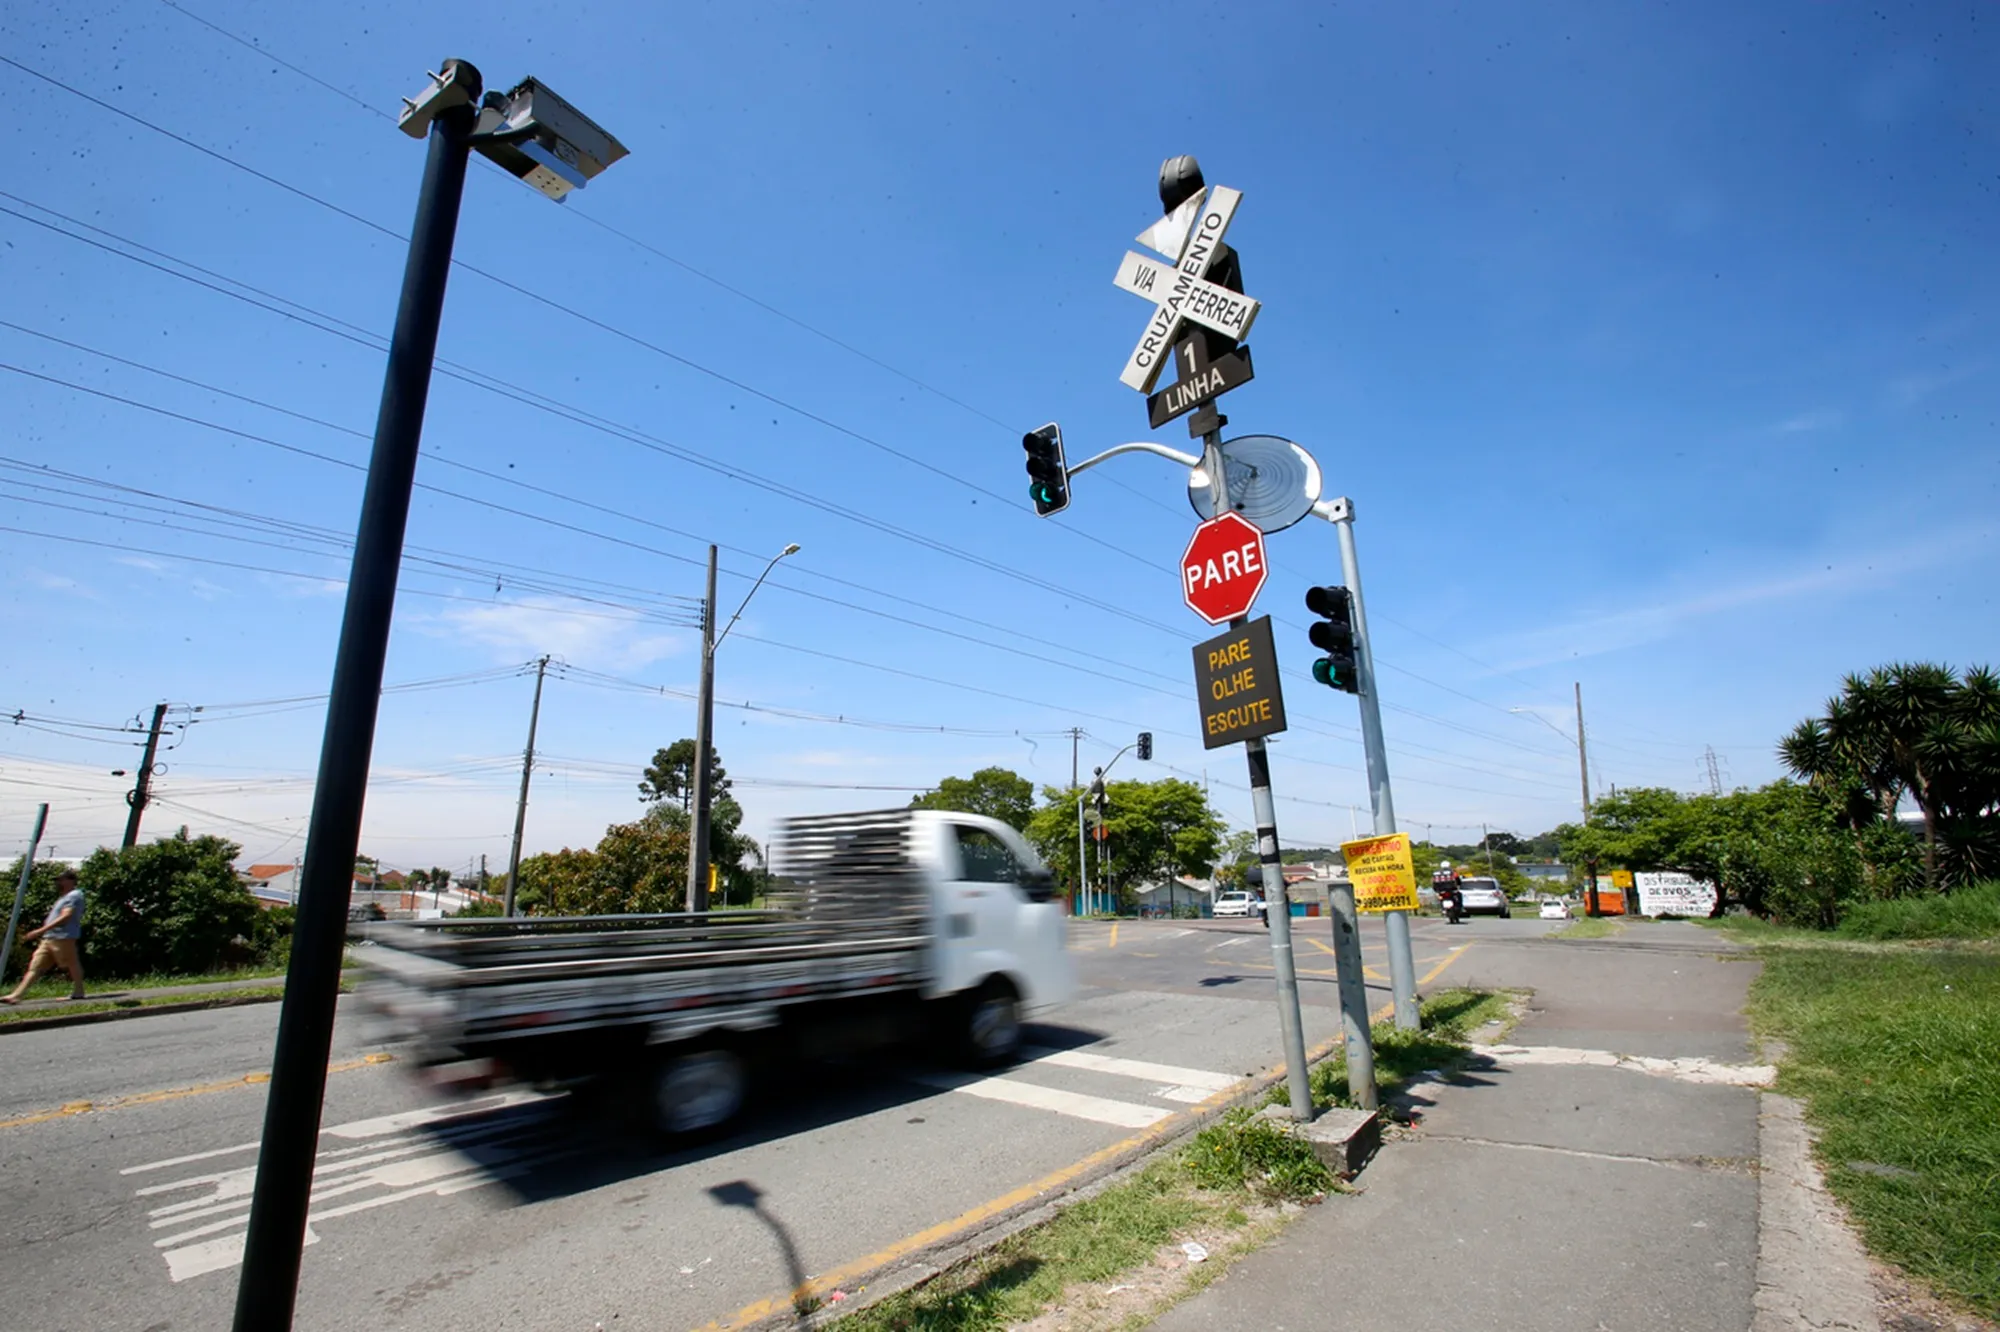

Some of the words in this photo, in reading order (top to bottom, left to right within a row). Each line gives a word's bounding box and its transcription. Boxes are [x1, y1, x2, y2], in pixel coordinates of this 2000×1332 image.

[1133, 263, 1157, 292] VIA
[1183, 284, 1248, 330] FÉRREA
[1135, 212, 1222, 368] CRUZAMENTO
[1183, 342, 1197, 373] 1
[1166, 367, 1225, 413] LINHA
[1186, 541, 1261, 594] PARE
[1208, 638, 1251, 672] PARE
[1211, 667, 1256, 700] OLHE
[1207, 698, 1272, 735] ESCUTE
[1387, 863, 1405, 871] HORA
